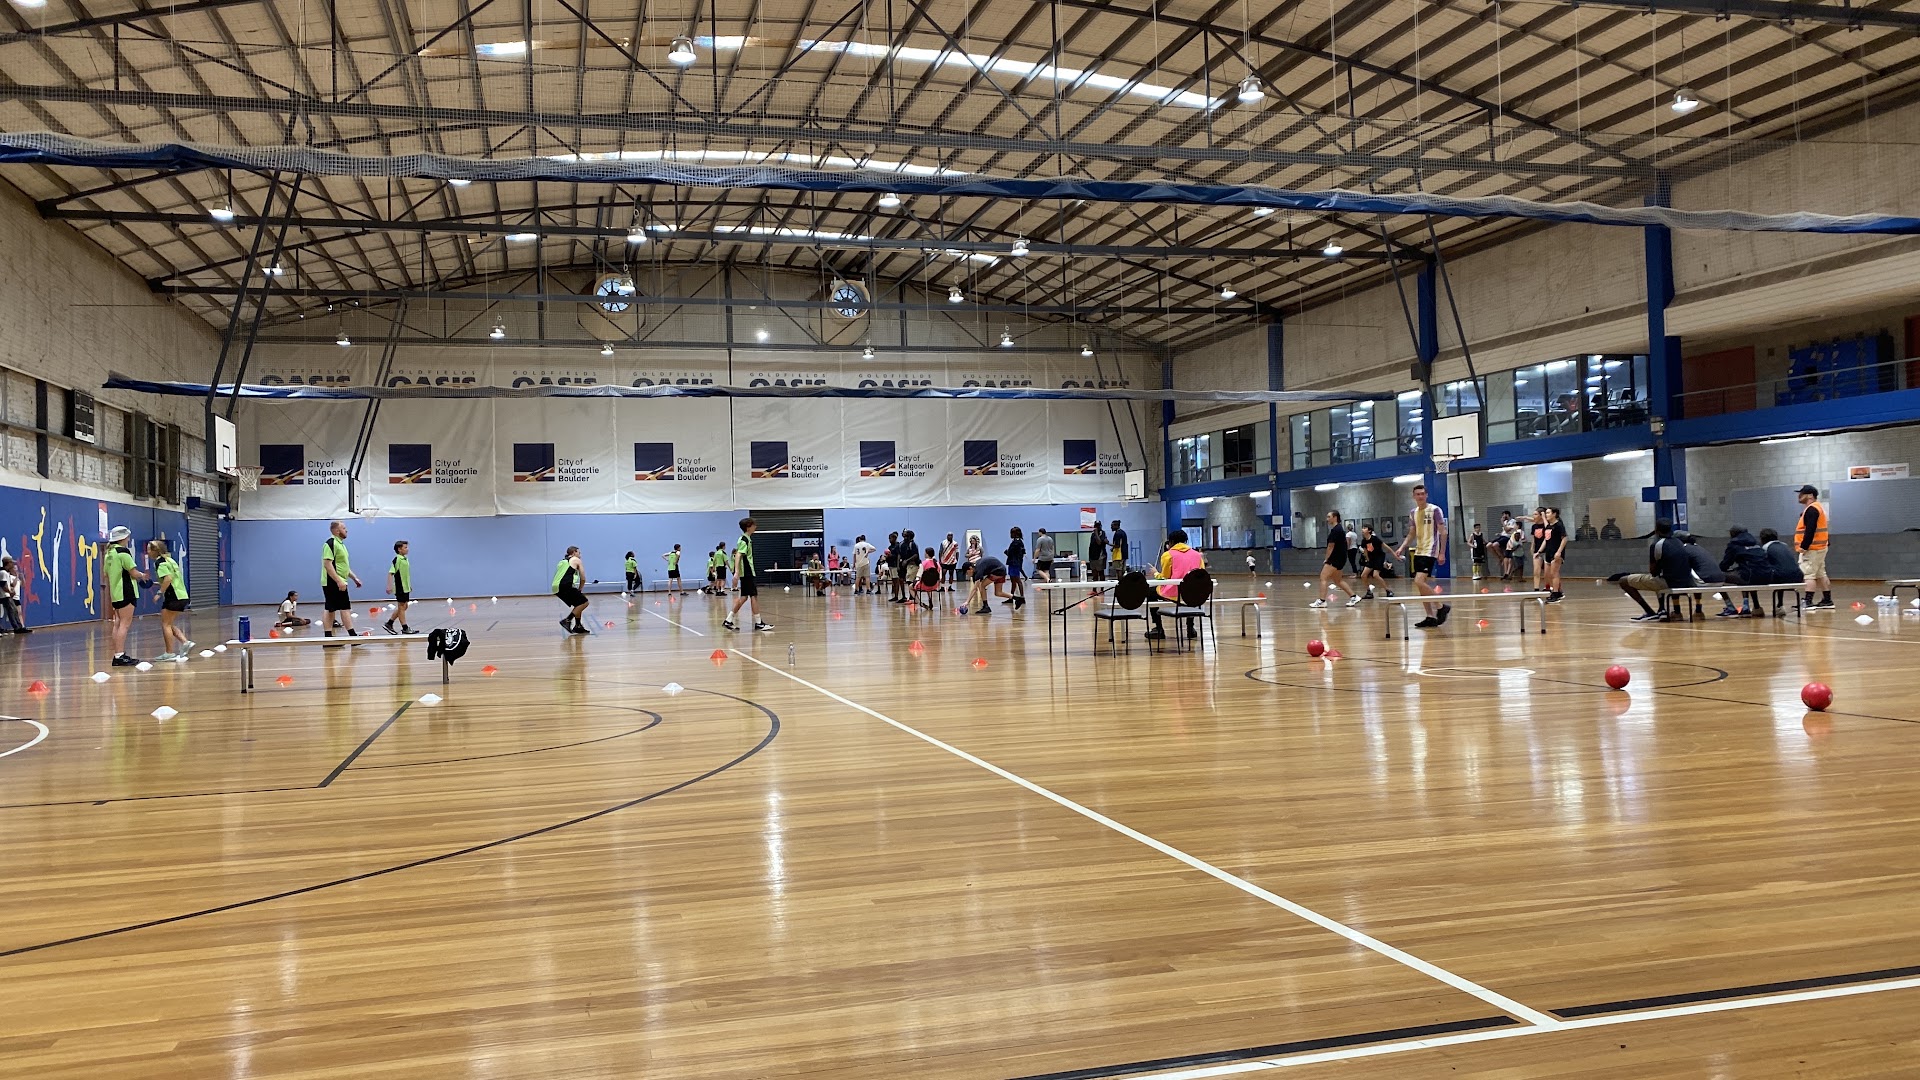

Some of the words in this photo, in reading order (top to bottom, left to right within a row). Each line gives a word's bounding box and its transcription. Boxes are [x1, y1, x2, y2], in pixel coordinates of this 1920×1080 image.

[677, 457, 692, 465] City
[693, 457, 701, 465] of
[791, 455, 805, 464] City
[806, 455, 814, 463] of
[898, 455, 912, 463] City
[1000, 454, 1013, 462] City
[1099, 453, 1111, 461] City
[307, 460, 324, 469] City
[325, 460, 335, 468] of
[435, 459, 451, 468] City
[452, 459, 461, 467] of
[558, 458, 574, 467] City
[575, 458, 583, 466] of
[898, 462, 934, 471] Kalgoorlie
[1000, 461, 1035, 470] Kalgoorlie
[435, 467, 478, 477] Kalgoorlie
[558, 466, 600, 476] Kalgoorlie
[677, 465, 717, 474] Kalgoorlie
[791, 463, 829, 472] Kalgoorlie
[677, 473, 707, 481] Boulder
[791, 471, 820, 479] Boulder
[307, 477, 341, 485] Boulder
[435, 476, 468, 484] Boulder
